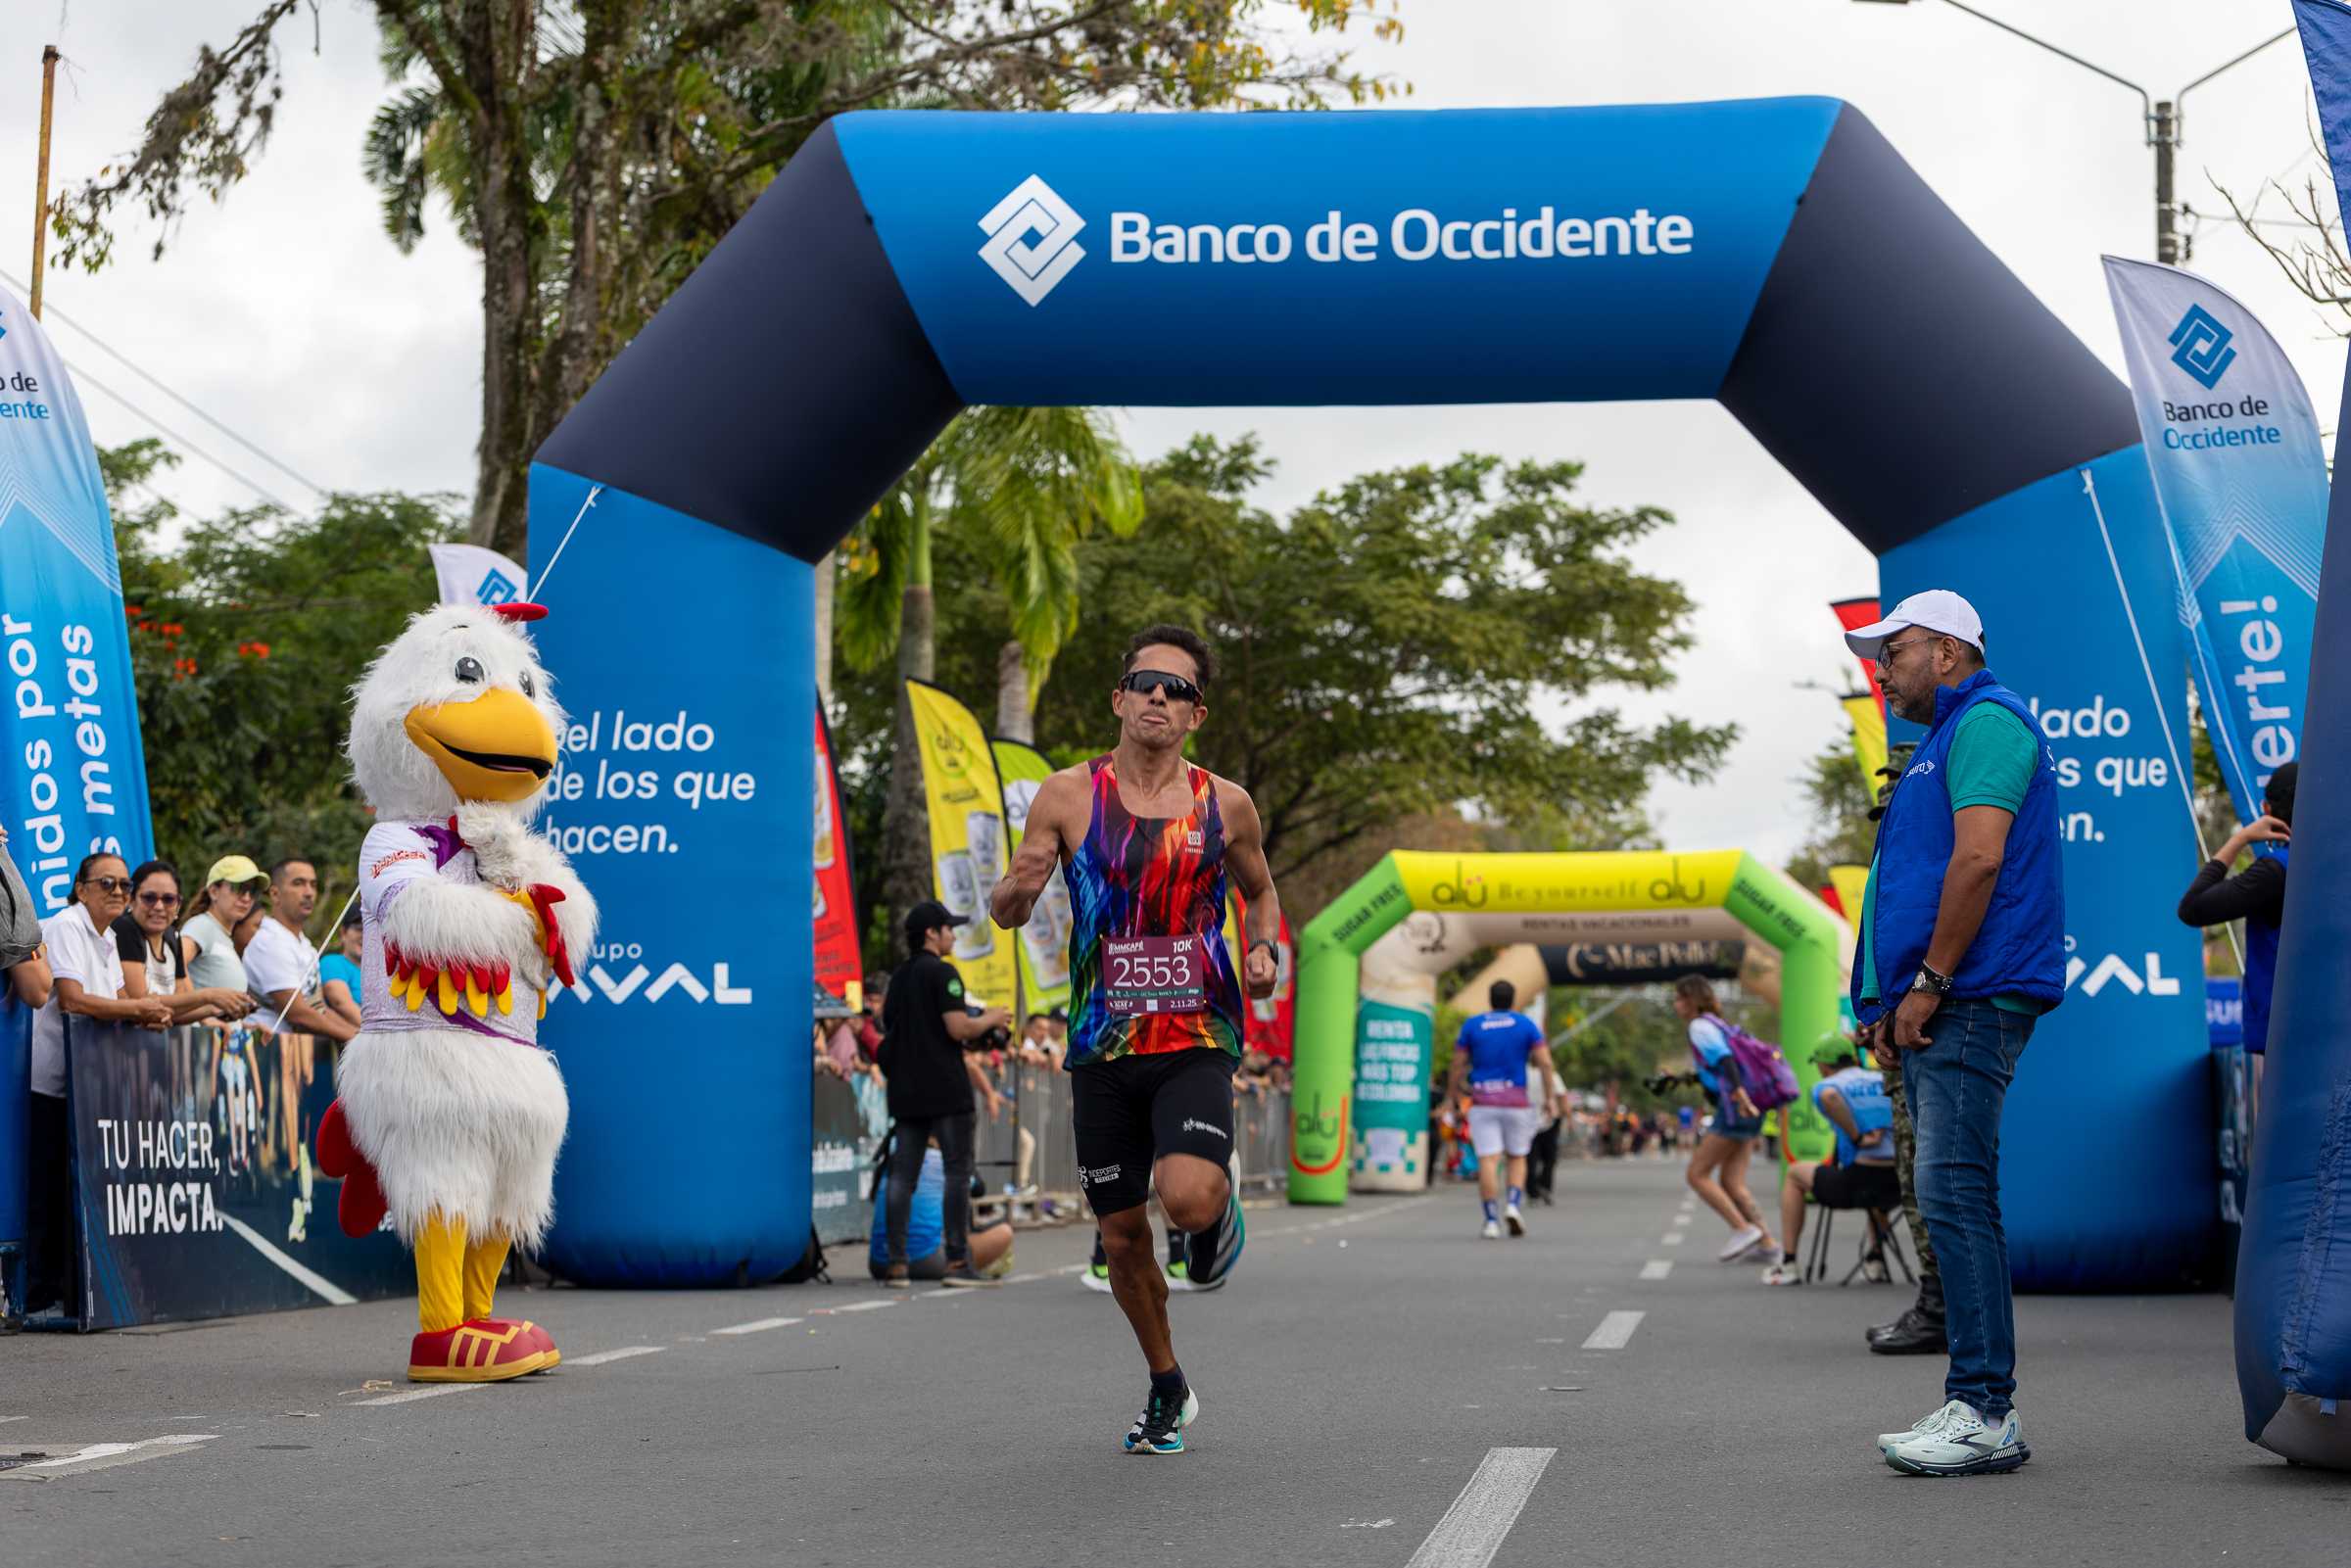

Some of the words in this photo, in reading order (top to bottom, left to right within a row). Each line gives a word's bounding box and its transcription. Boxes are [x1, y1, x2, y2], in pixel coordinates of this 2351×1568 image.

[1111, 211, 1292, 263] Banco
[1306, 210, 1379, 262] de
[1391, 205, 1695, 261] Occidente
[11, 371, 38, 393] de
[2163, 401, 2233, 422] Banco
[2240, 395, 2270, 416] de
[2163, 424, 2281, 451] Occidente
[2, 613, 56, 719] por
[2220, 594, 2296, 788] erte!
[62, 624, 116, 816] metas
[556, 710, 600, 752] el
[612, 710, 715, 752] lado
[2030, 694, 2132, 739] lado
[547, 761, 585, 801] de
[597, 759, 658, 801] los
[674, 770, 756, 811] que
[2094, 757, 2169, 798] que
[546, 815, 679, 855] hacen.
[1174, 939, 1193, 953] 10K
[547, 962, 752, 1005] AVAL
[1114, 956, 1191, 987] 2553
[98, 1119, 130, 1169] TU
[138, 1119, 220, 1176] HACER,
[106, 1182, 224, 1237] IMPACTA.
